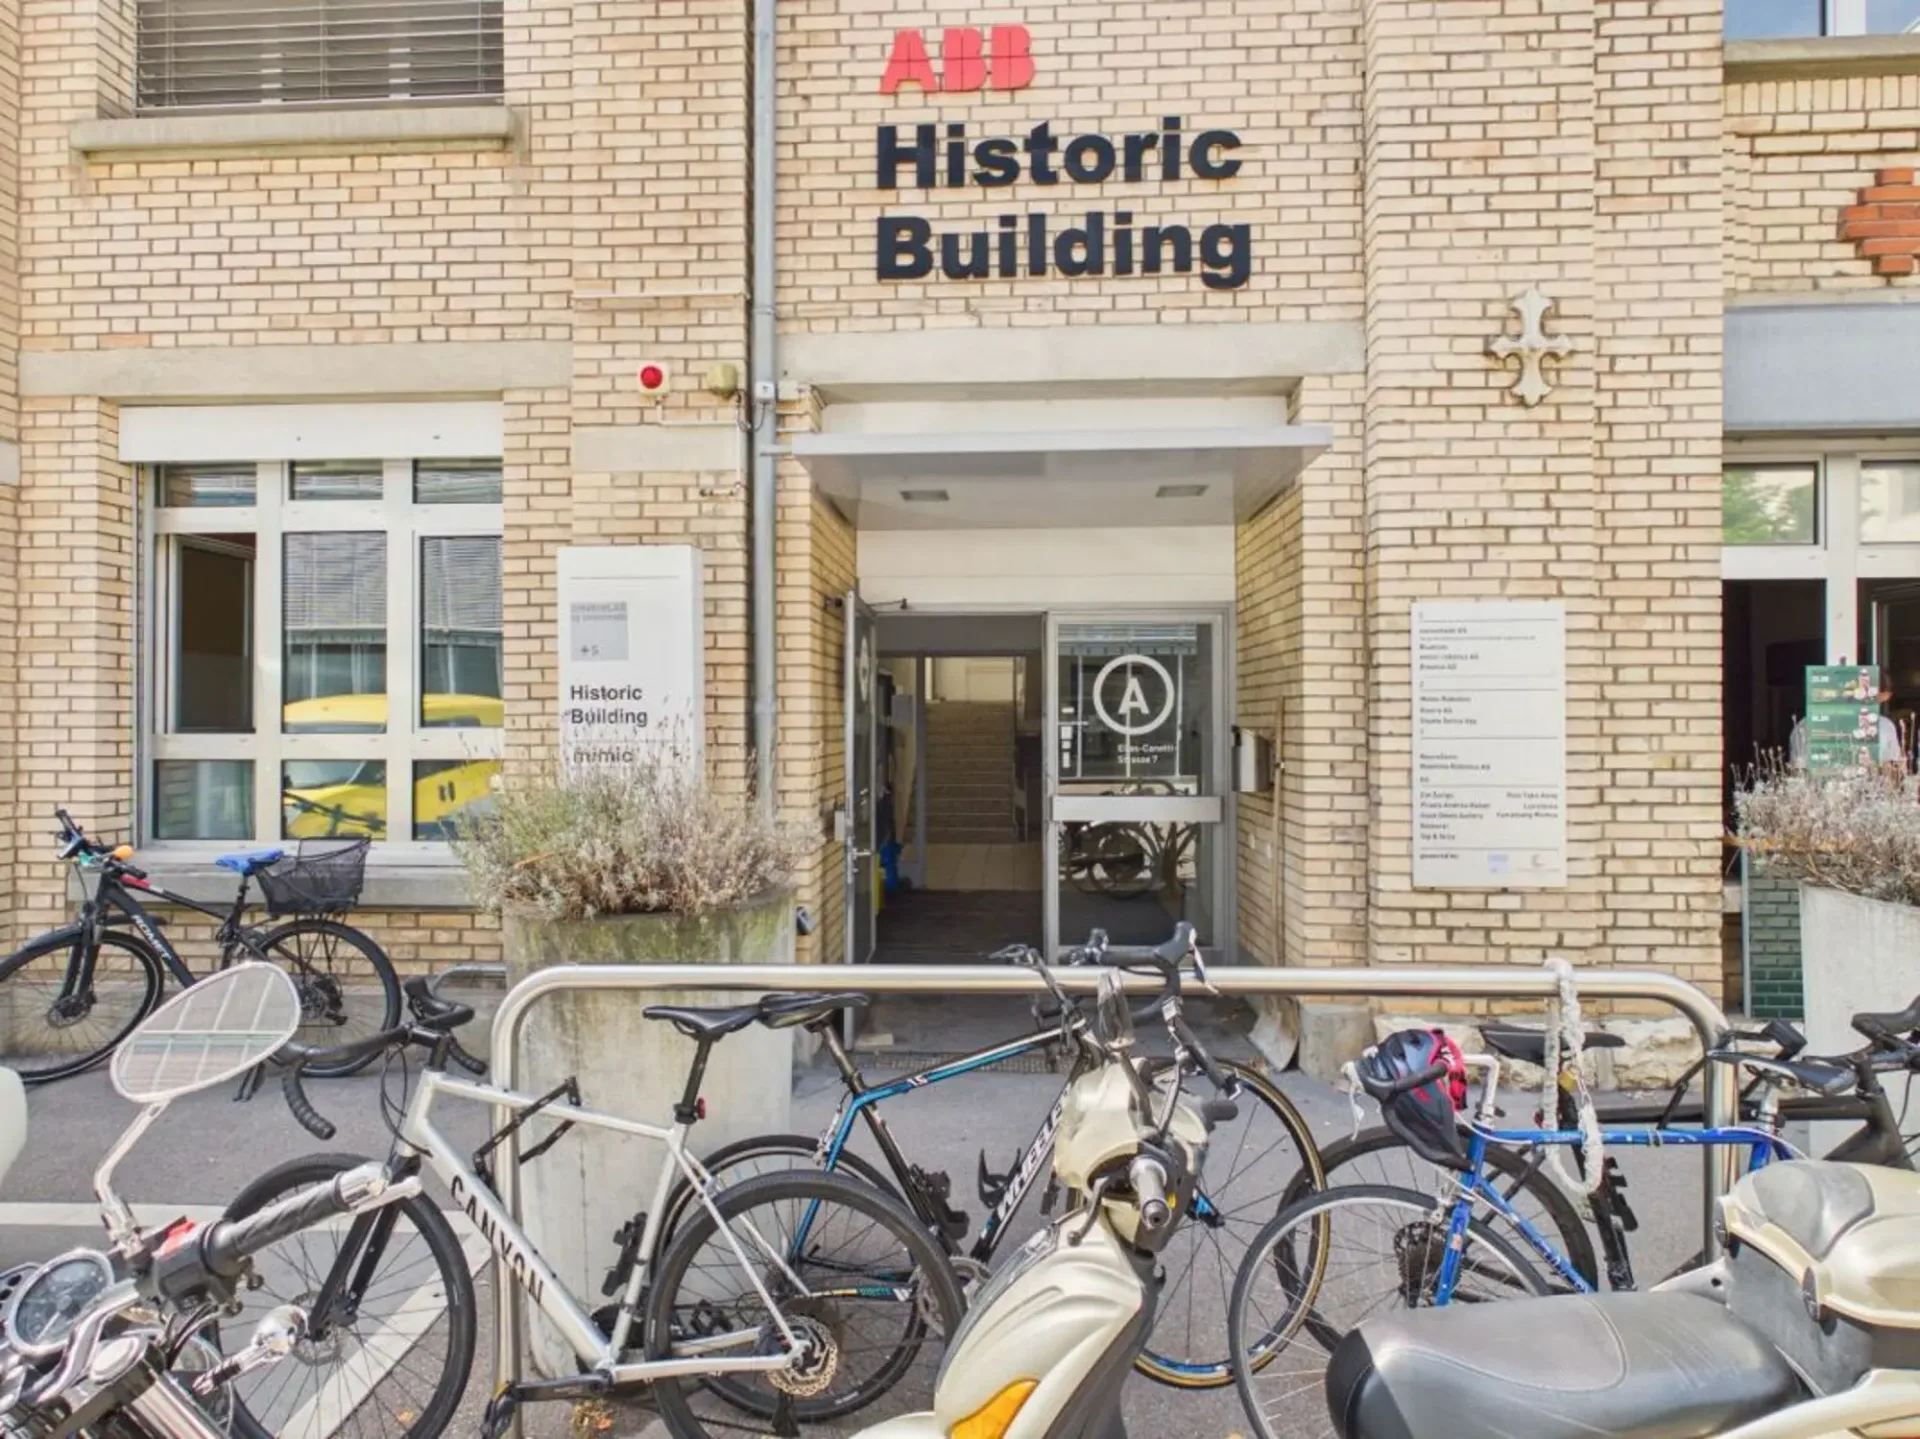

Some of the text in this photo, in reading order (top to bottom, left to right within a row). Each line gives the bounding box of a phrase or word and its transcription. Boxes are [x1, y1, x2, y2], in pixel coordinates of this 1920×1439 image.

[879, 23, 1036, 94] ABB
[877, 116, 1242, 189] Historic
[877, 211, 1251, 290] Building
[571, 684, 643, 700] Historic
[1118, 677, 1150, 715] A
[571, 707, 648, 728] Building
[573, 746, 634, 763] mimic
[130, 914, 172, 960] ROMET
[451, 1175, 545, 1304] CANYON
